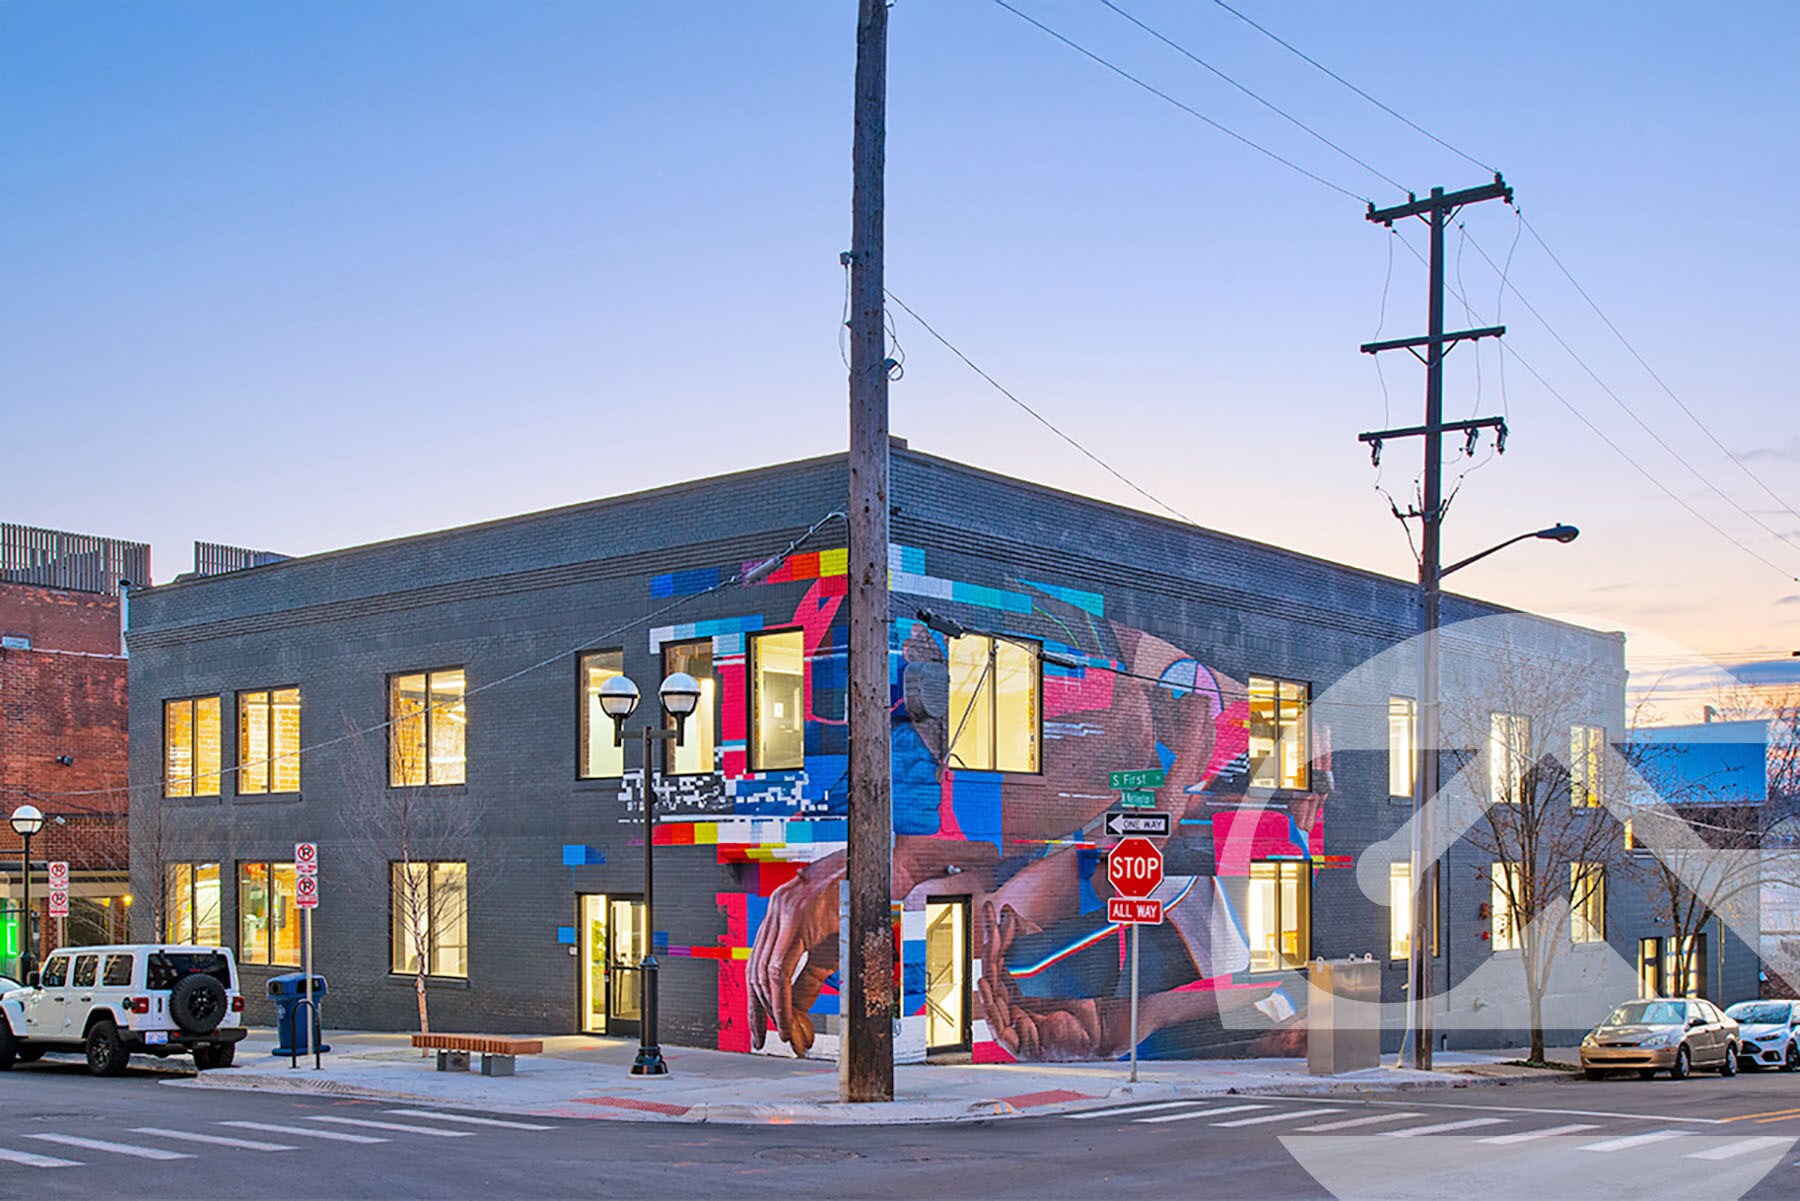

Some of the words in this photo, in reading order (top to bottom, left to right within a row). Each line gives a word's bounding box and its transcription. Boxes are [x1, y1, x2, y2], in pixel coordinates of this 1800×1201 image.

[1112, 774, 1119, 786] S
[1123, 773, 1146, 785] First
[1123, 820, 1141, 829] ONE
[1144, 820, 1162, 829] WAY
[1112, 856, 1159, 879] STOP
[1112, 903, 1133, 918] ALL
[1136, 904, 1158, 918] WAY
